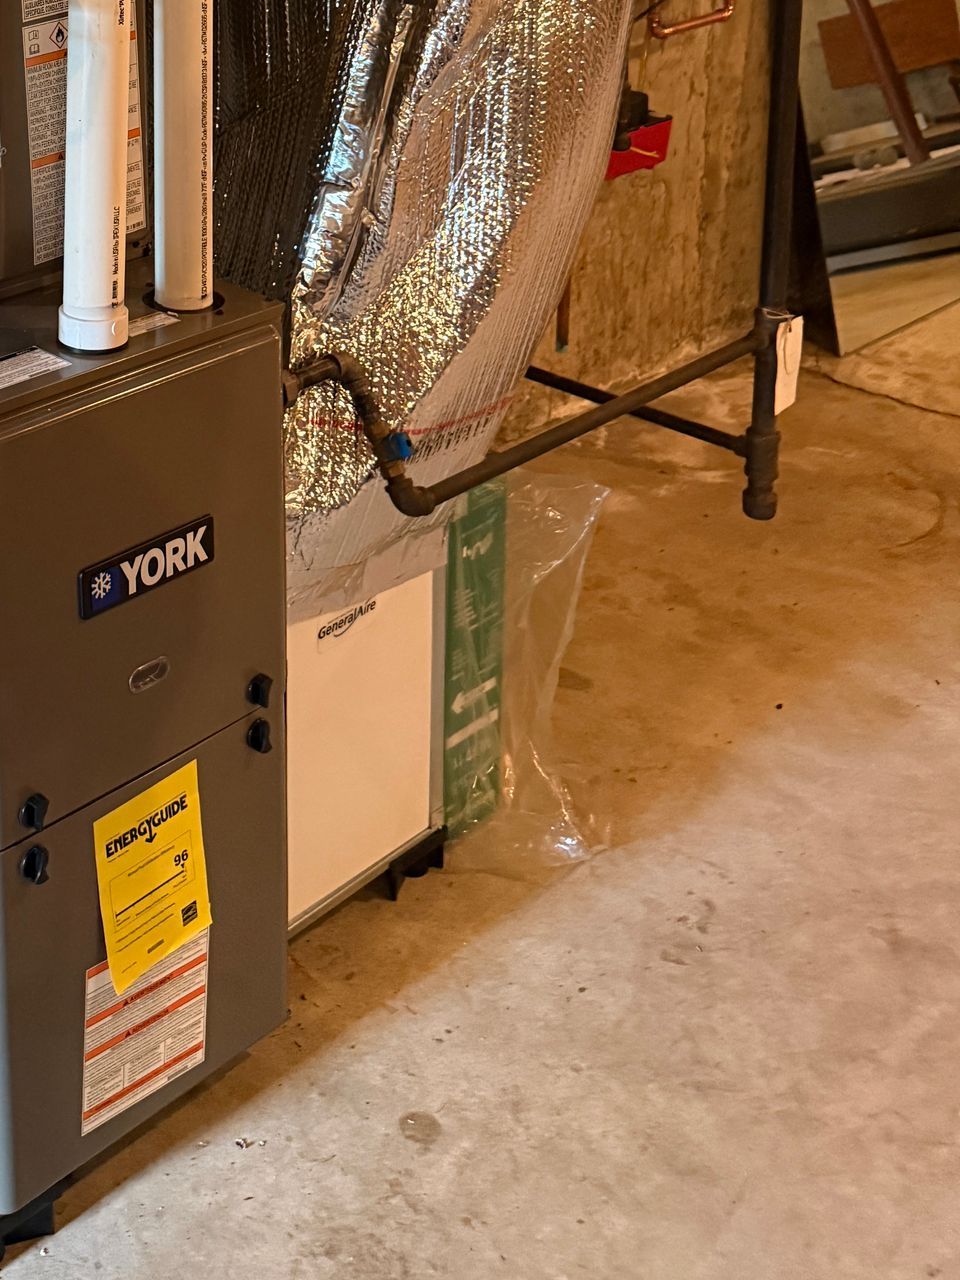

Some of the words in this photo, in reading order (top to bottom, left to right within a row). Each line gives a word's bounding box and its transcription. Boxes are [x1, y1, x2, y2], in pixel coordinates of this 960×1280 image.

[112, 226, 120, 240] IPEX
[120, 525, 208, 595] YORK
[318, 600, 376, 639] GeneralAire
[105, 794, 188, 858] ENERGYGUIDE
[174, 849, 188, 867] 96
